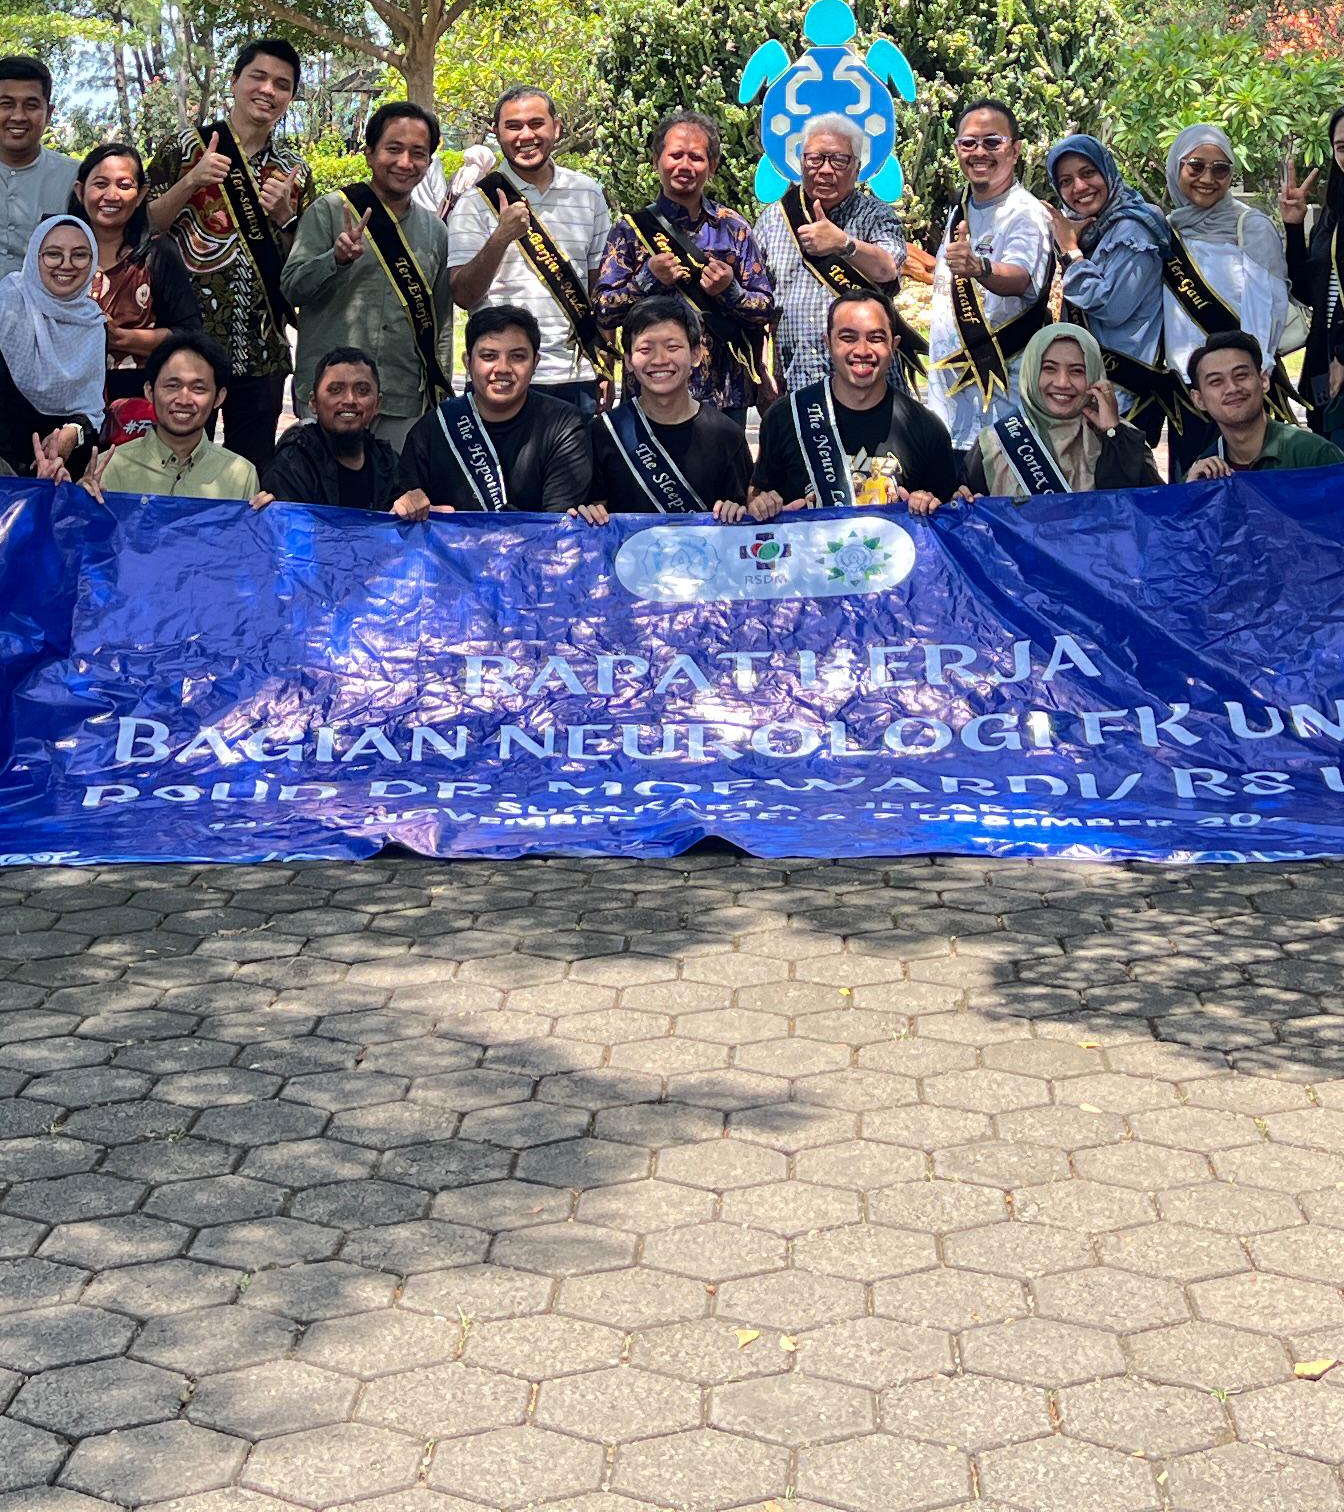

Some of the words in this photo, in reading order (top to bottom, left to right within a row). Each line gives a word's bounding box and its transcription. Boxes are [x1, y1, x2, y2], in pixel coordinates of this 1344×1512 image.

[954, 274, 981, 324] boratif
[1167, 256, 1213, 310] Ter-Gaul
[456, 415, 475, 441] The
[806, 403, 825, 430] The
[1003, 416, 1024, 439] The
[635, 443, 657, 470] The
[812, 434, 837, 483] Neuro
[744, 574, 789, 586] RSDM
[464, 650, 774, 696] RAPAT
[115, 715, 467, 764] BAGIAN
[497, 710, 1053, 761] NEUROLOGI
[1081, 701, 1203, 748] FK
[1172, 766, 1296, 799] RS
